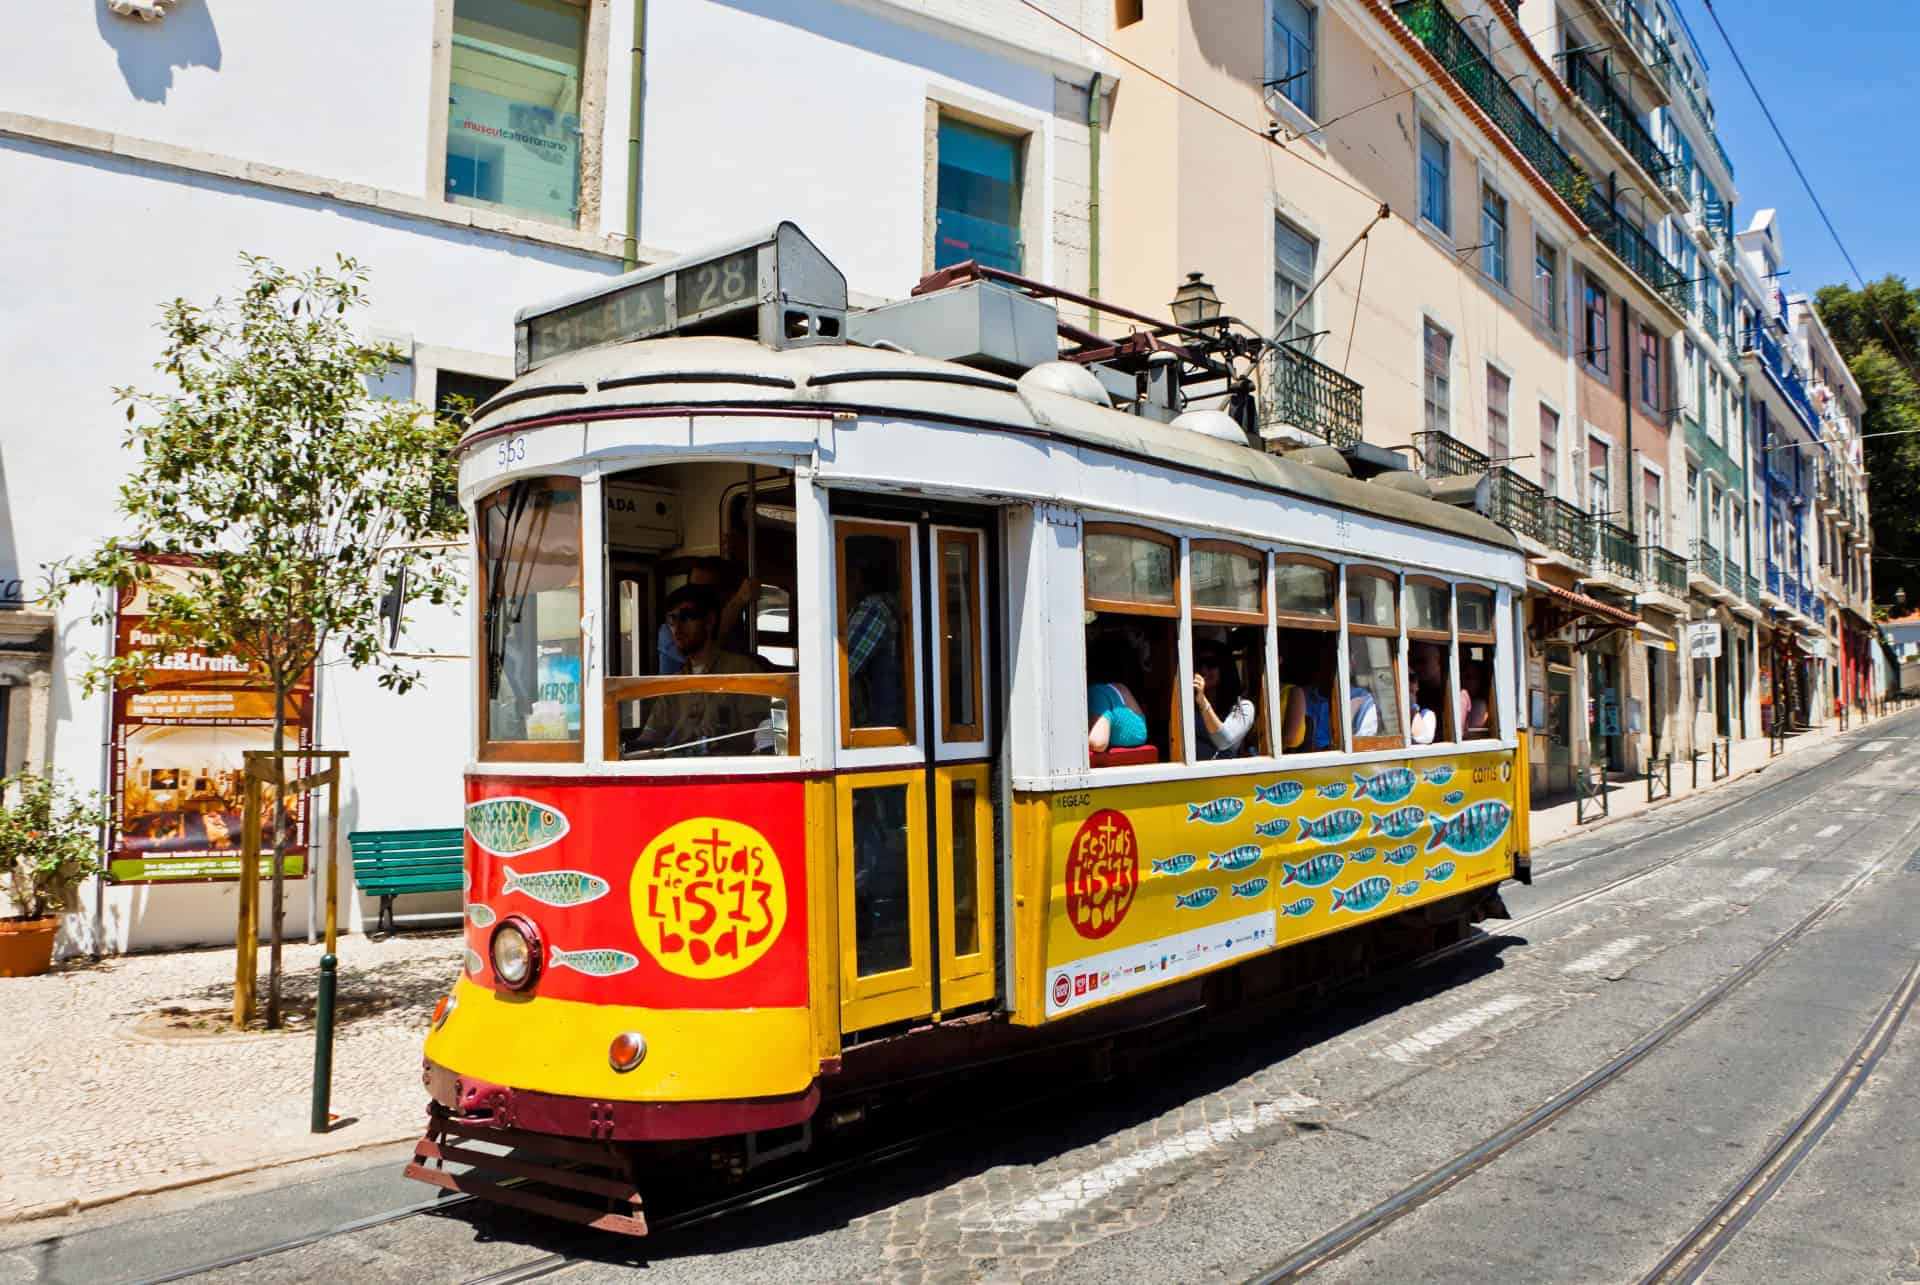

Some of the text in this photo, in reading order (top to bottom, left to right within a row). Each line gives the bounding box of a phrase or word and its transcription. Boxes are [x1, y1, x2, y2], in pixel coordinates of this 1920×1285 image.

[541, 258, 747, 353] ESTELA 28
[498, 437, 526, 465] 553
[653, 828, 764, 877] Festas
[664, 874, 682, 888] de
